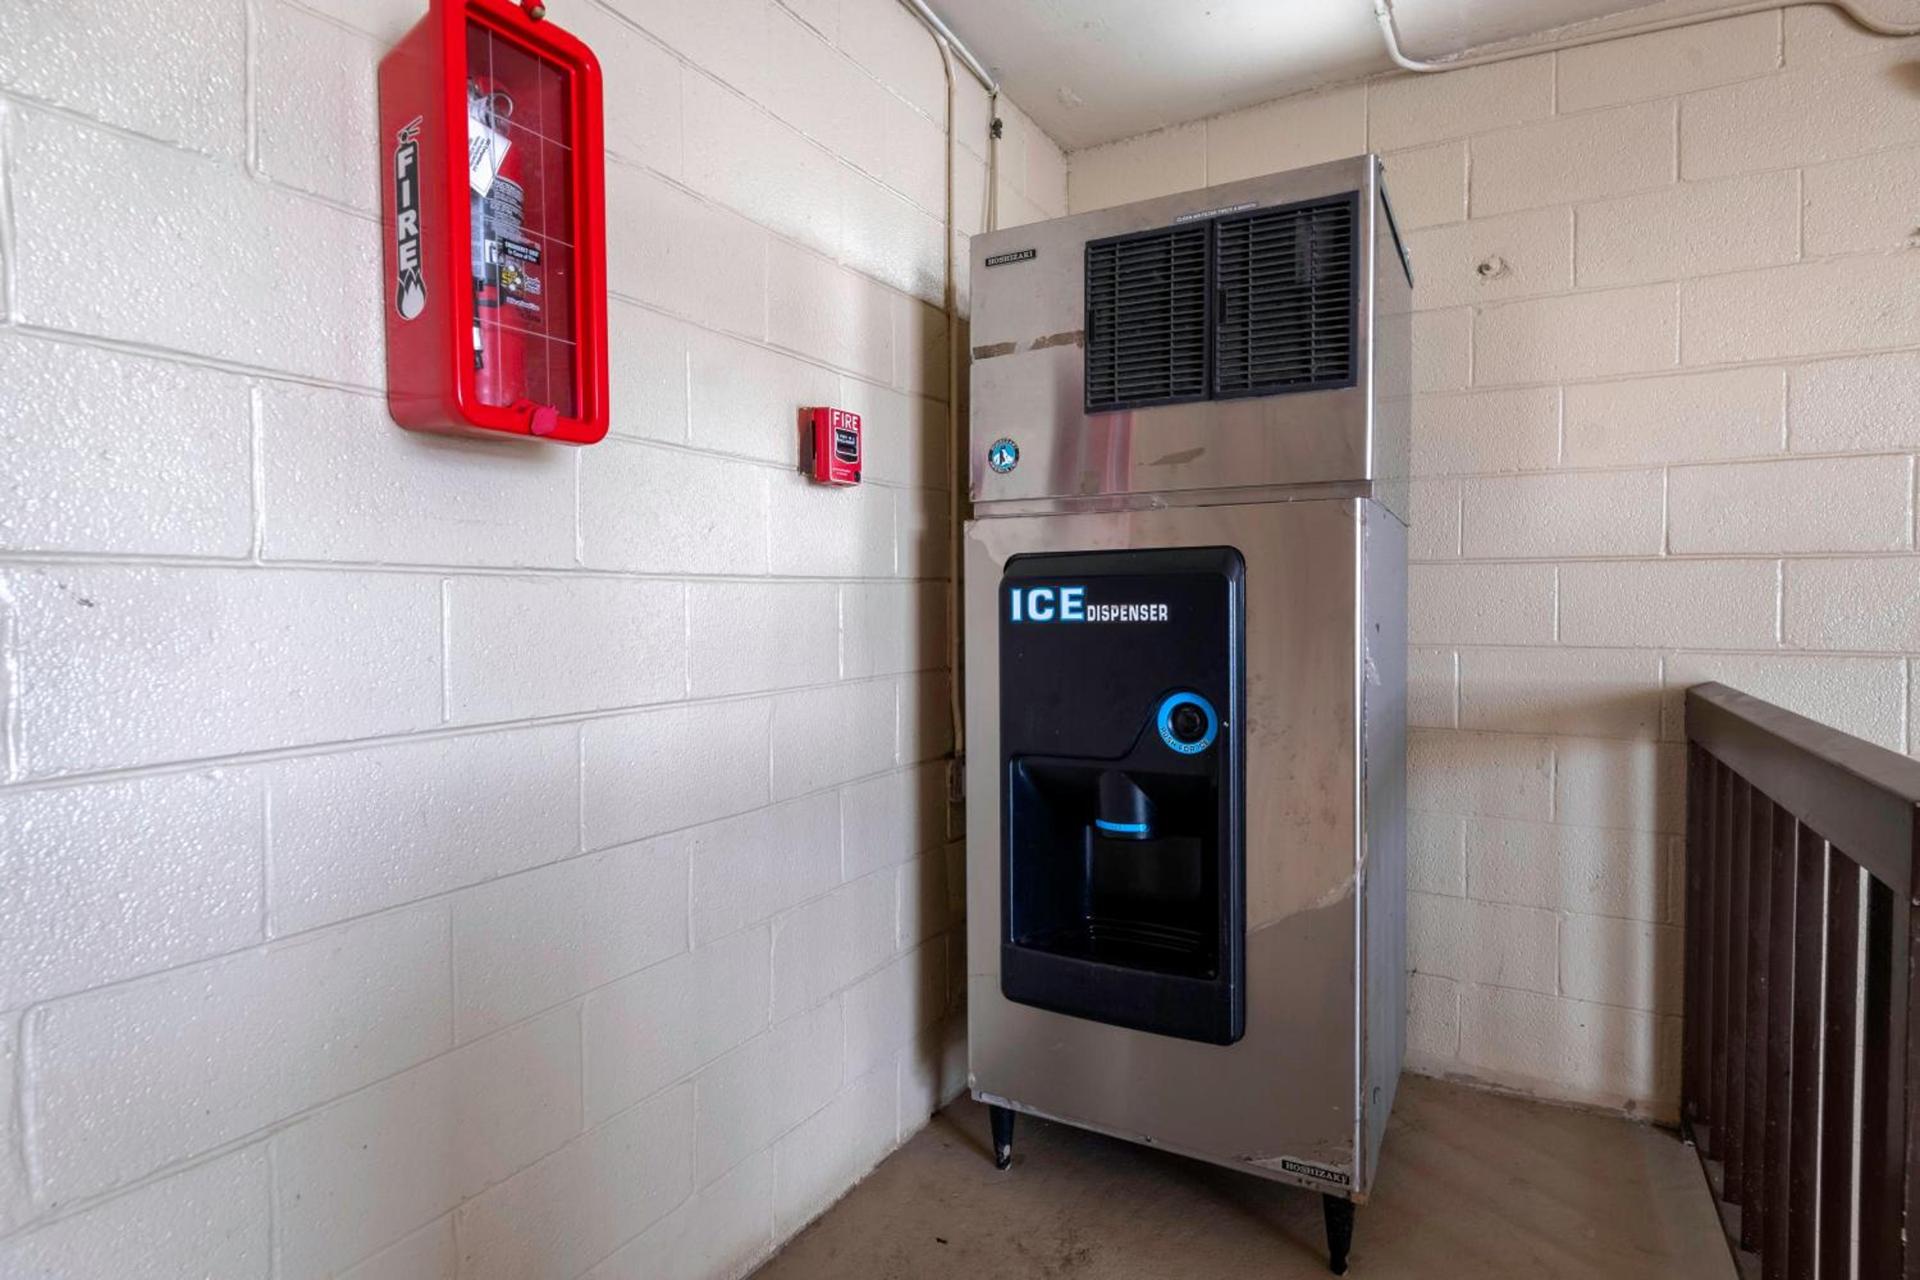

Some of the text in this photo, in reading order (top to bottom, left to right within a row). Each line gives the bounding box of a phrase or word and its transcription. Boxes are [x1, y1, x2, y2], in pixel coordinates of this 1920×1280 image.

[398, 146, 419, 272] FIRE
[987, 250, 1033, 265] HOSHIZAKI
[833, 411, 858, 431] FIRE
[1011, 586, 1169, 622] ICE DISPENSER
[1285, 1161, 1346, 1184] HOSHIZAKI
